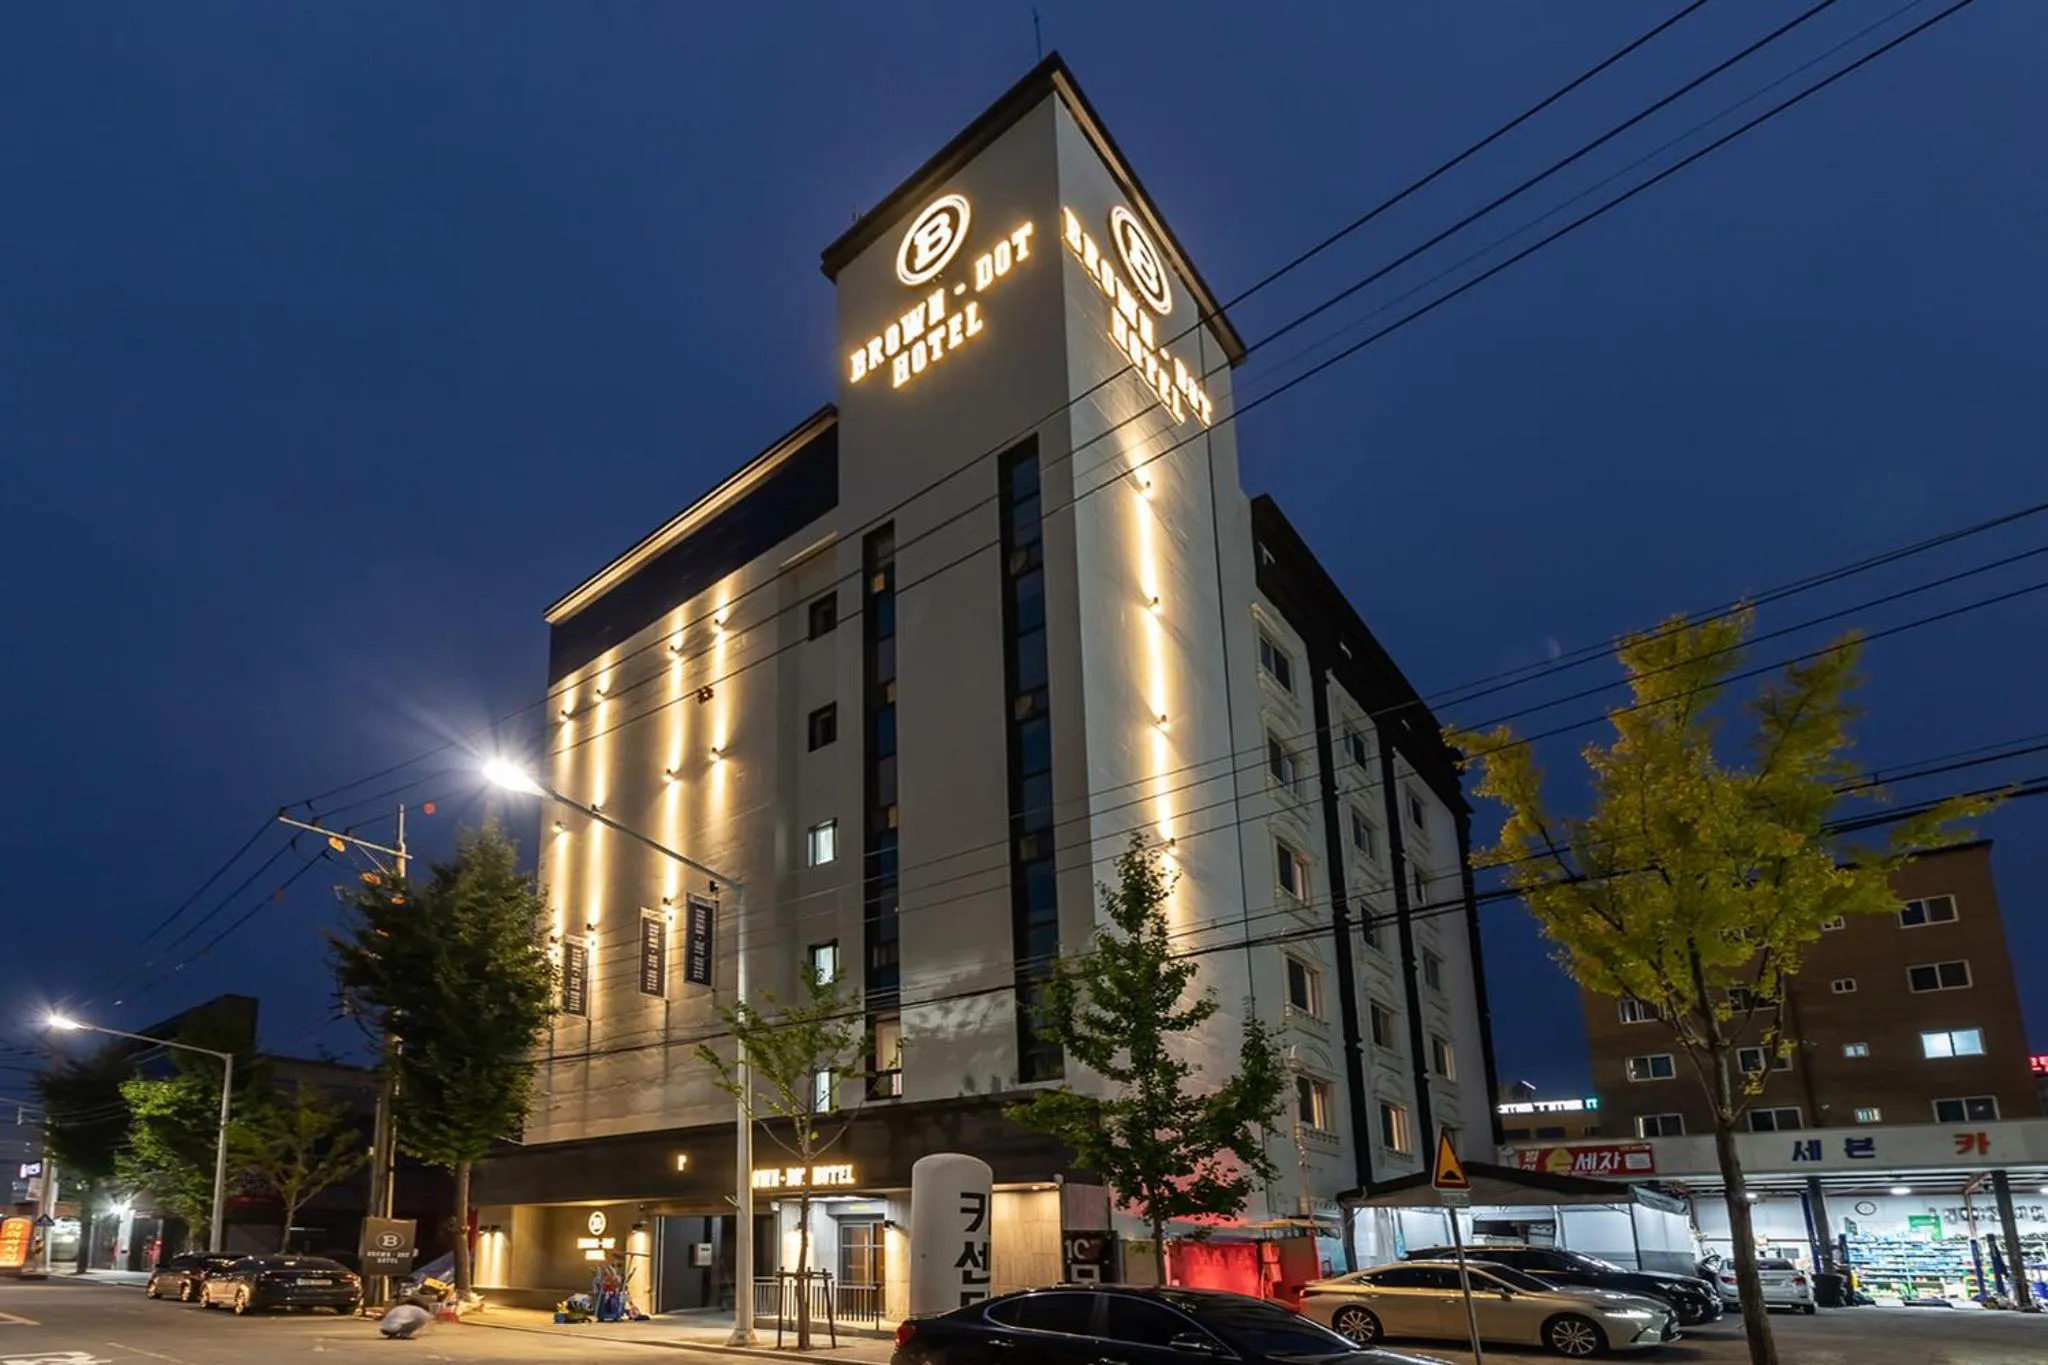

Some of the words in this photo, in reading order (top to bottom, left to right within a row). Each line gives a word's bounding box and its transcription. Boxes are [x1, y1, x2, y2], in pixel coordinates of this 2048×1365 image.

[892, 300, 984, 389] HOTEL
[1953, 1132, 1991, 1156] 카
[382, 1234, 398, 1247] B
